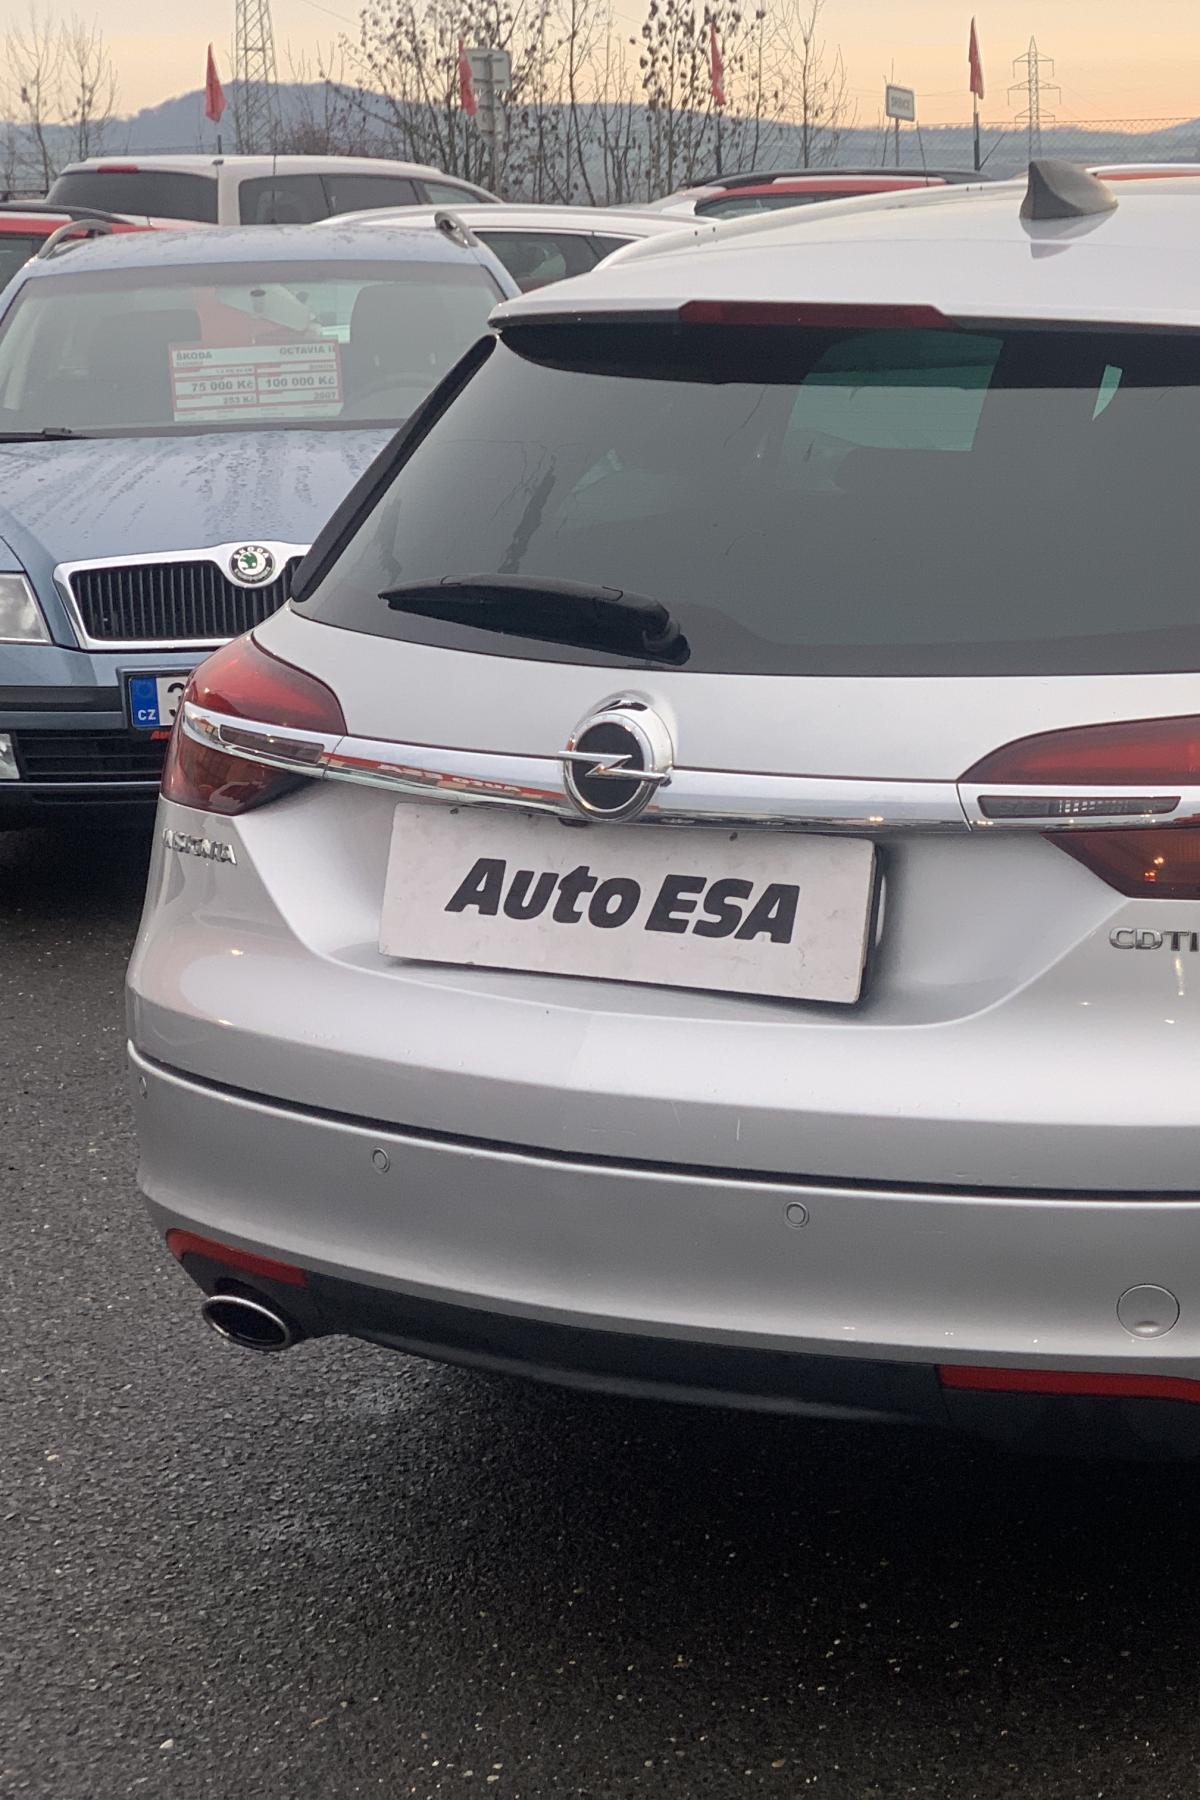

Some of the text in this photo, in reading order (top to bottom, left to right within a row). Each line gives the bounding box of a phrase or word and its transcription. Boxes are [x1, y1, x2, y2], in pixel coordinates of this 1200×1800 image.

[280, 345, 326, 355] OCTAVIA
[192, 382, 206, 393] 75
[210, 380, 233, 391] 000
[267, 377, 288, 388] 100
[292, 376, 315, 387] 000
[137, 709, 157, 721] CZ
[444, 857, 801, 945] Auto ESA
[1109, 926, 1200, 952] CDTI
